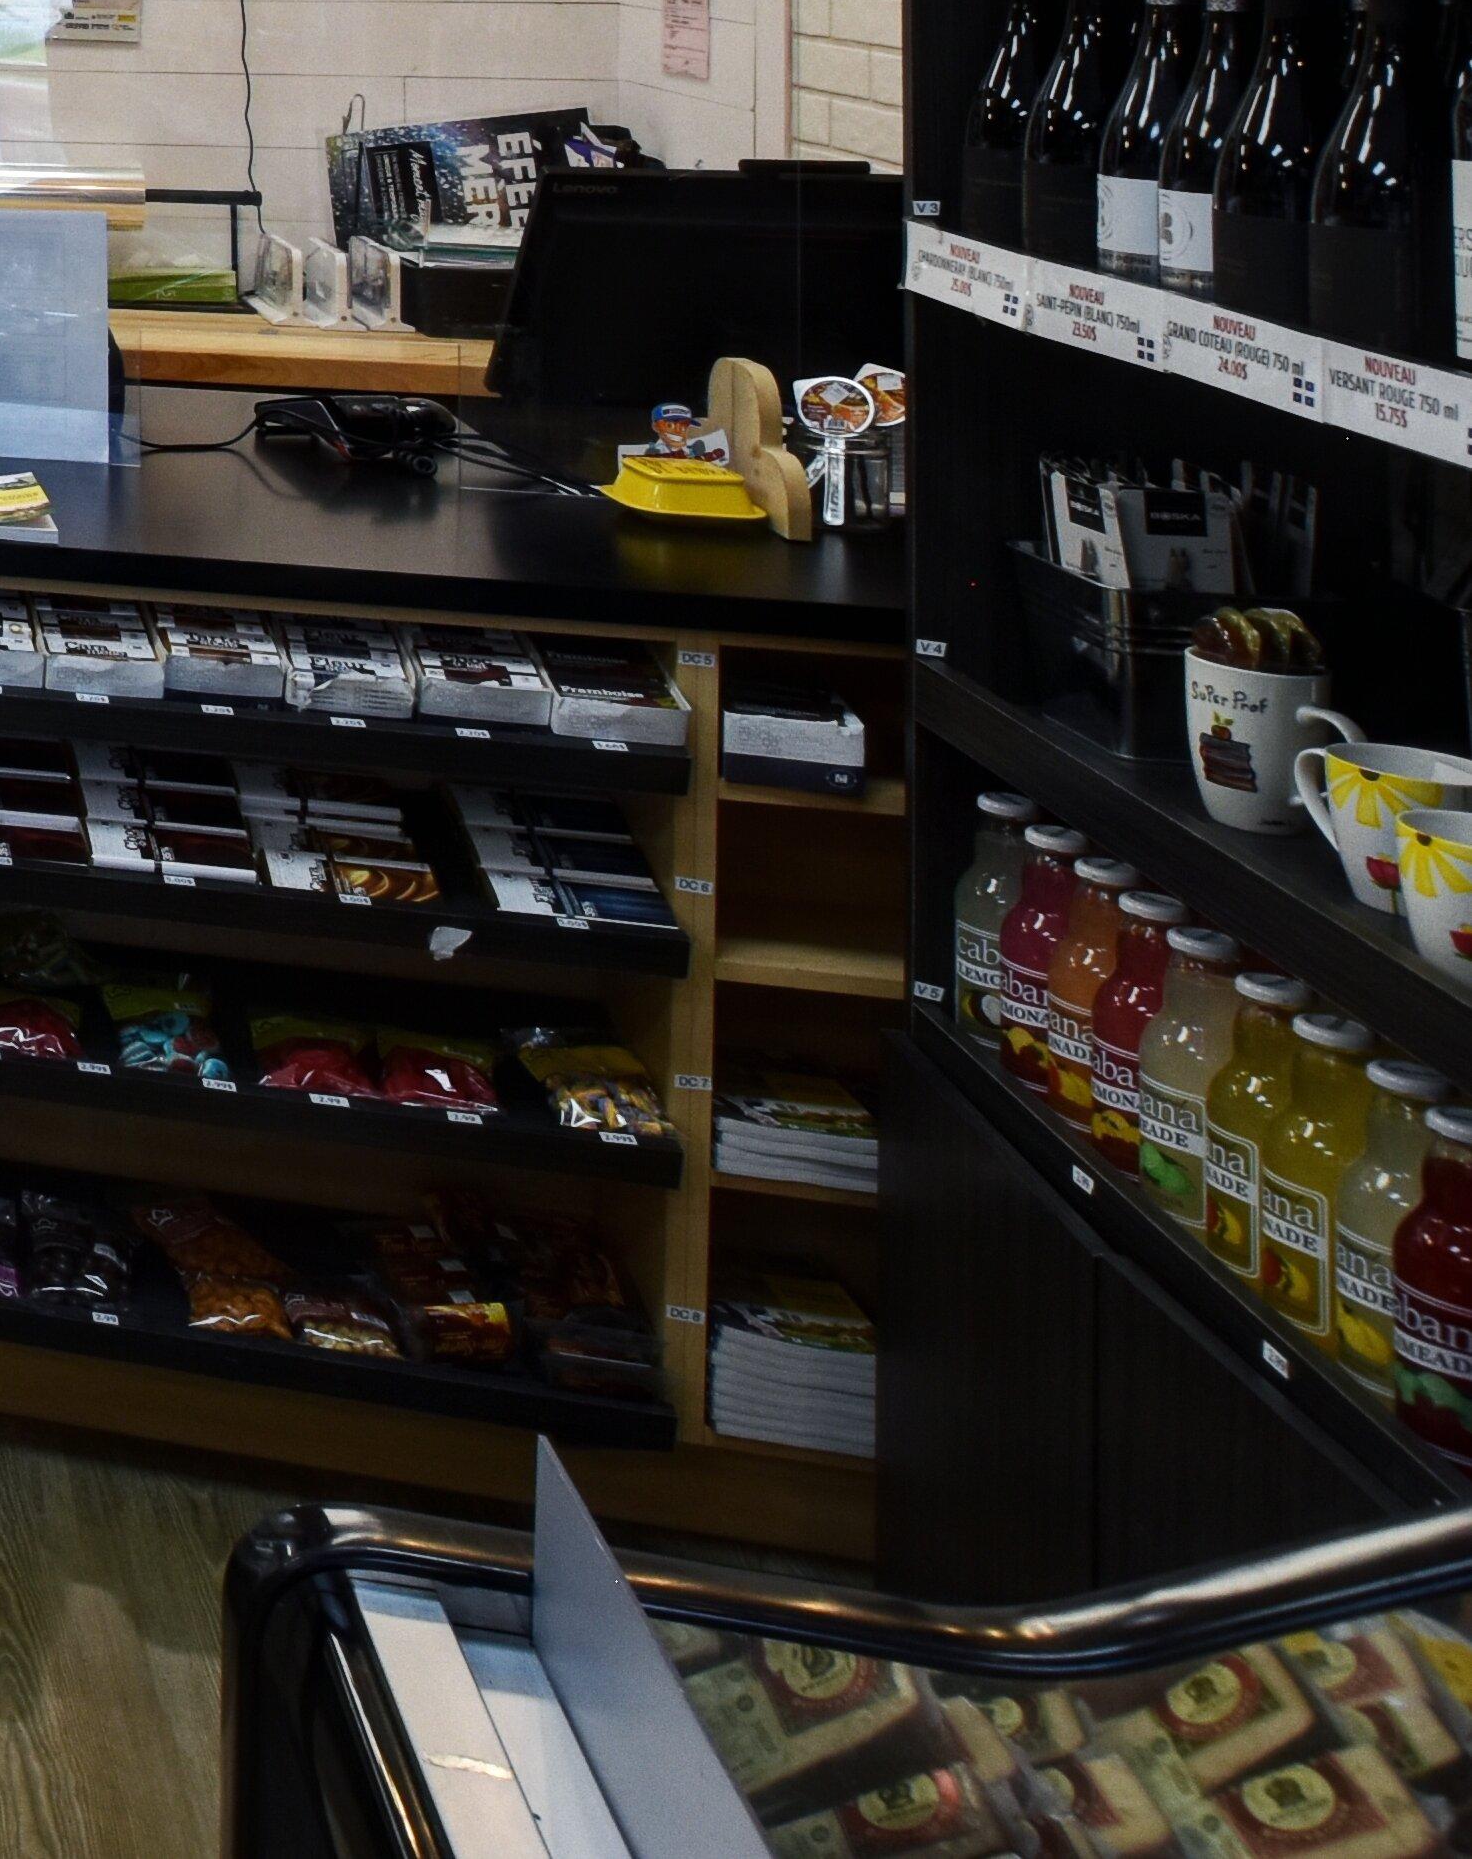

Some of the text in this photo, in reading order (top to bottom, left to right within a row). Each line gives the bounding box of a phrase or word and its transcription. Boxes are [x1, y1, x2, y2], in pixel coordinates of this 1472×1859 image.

[916, 203, 939, 214] V 3
[950, 243, 980, 264] NOUVEAU
[1069, 284, 1104, 306] NOUVEAU
[1036, 293, 1082, 319] SAINT-PEPIN
[1084, 304, 1114, 326] (BLANC)
[1213, 315, 1256, 341] NOUVEAU
[1167, 320, 1304, 377] GRAND COTEAU (ROUGE) 750 ml
[1218, 356, 1248, 381] 24.00$
[1364, 356, 1416, 386] NOUVEAU
[1329, 368, 1458, 421] VERSANT ROUGE 750 ml
[1375, 402, 1408, 429] 15.75$
[683, 653, 713, 667] DC 5
[560, 685, 645, 700] Framboise
[1232, 690, 1270, 715] Prof
[680, 878, 699, 892] DC
[678, 1076, 698, 1088] DC
[670, 1307, 690, 1320] DC
